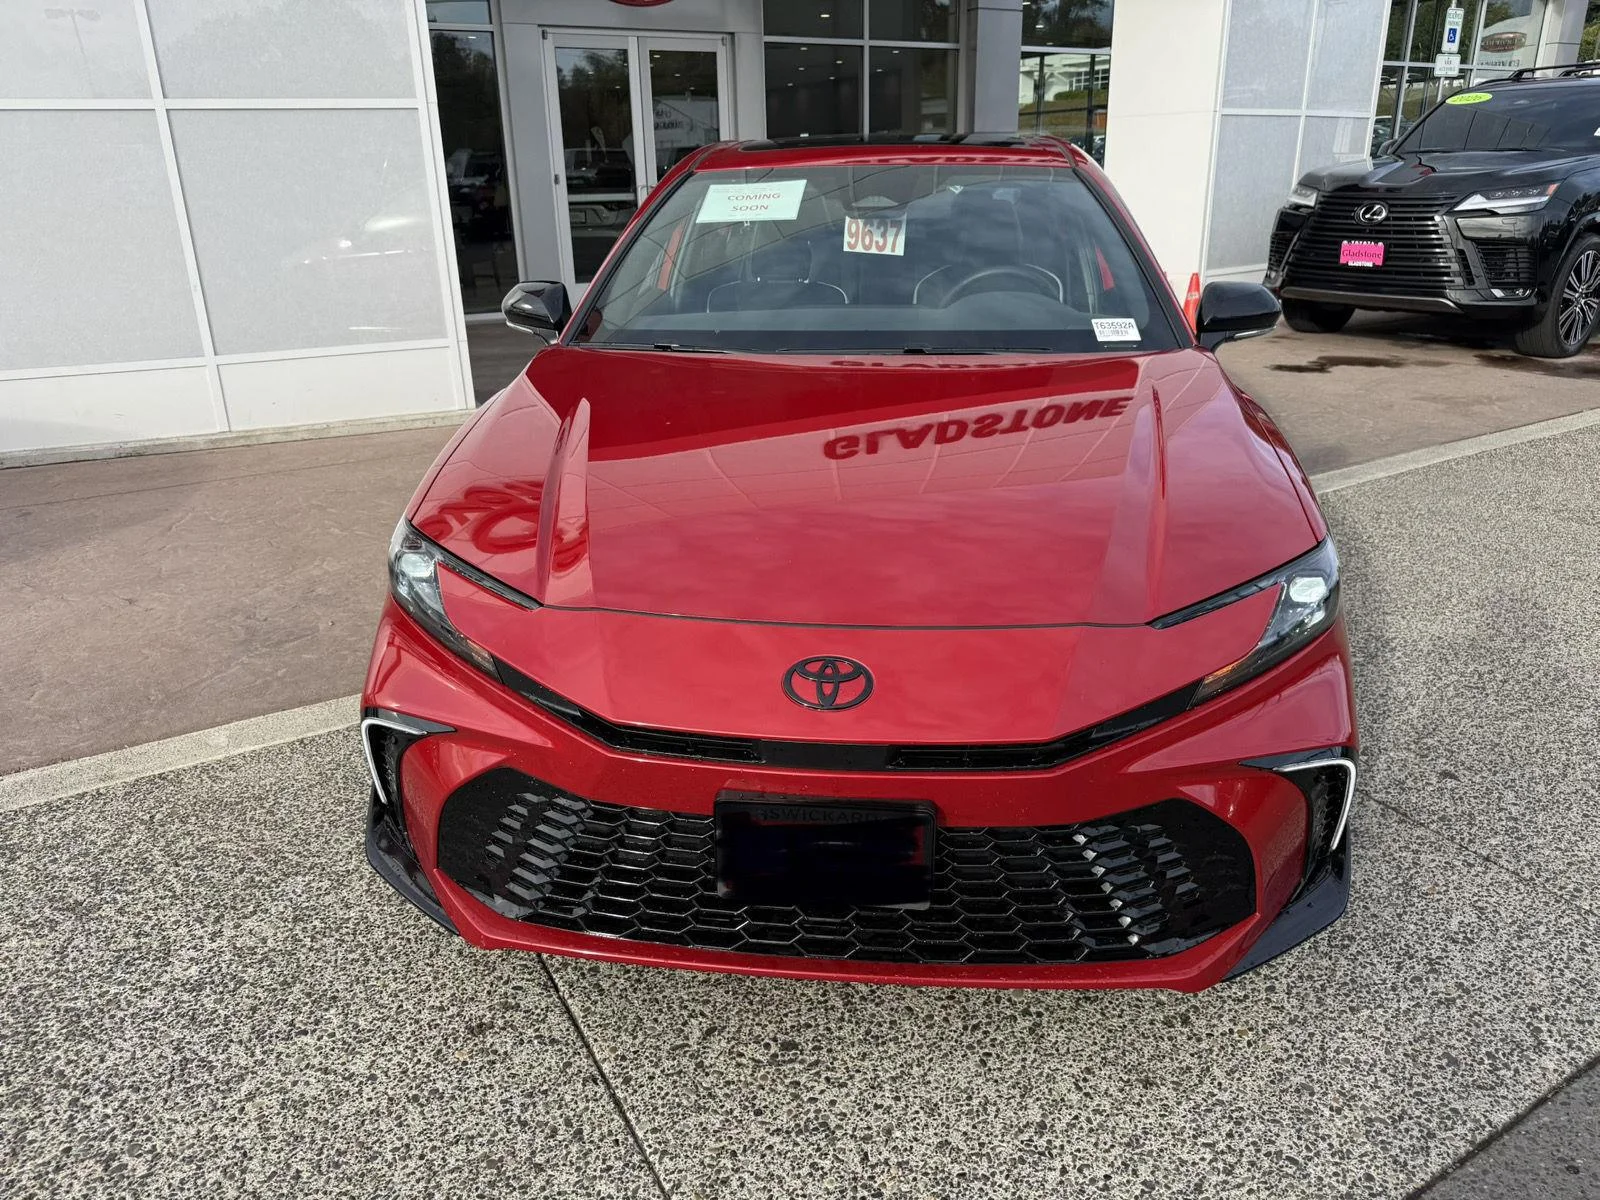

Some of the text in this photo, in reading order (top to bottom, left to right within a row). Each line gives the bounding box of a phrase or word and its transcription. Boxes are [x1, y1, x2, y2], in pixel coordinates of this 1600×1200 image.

[727, 192, 781, 201] COMING
[731, 204, 769, 212] SOON
[847, 218, 903, 253] 9637
[1342, 250, 1381, 259] Gladstone
[1094, 321, 1135, 330] T63592A
